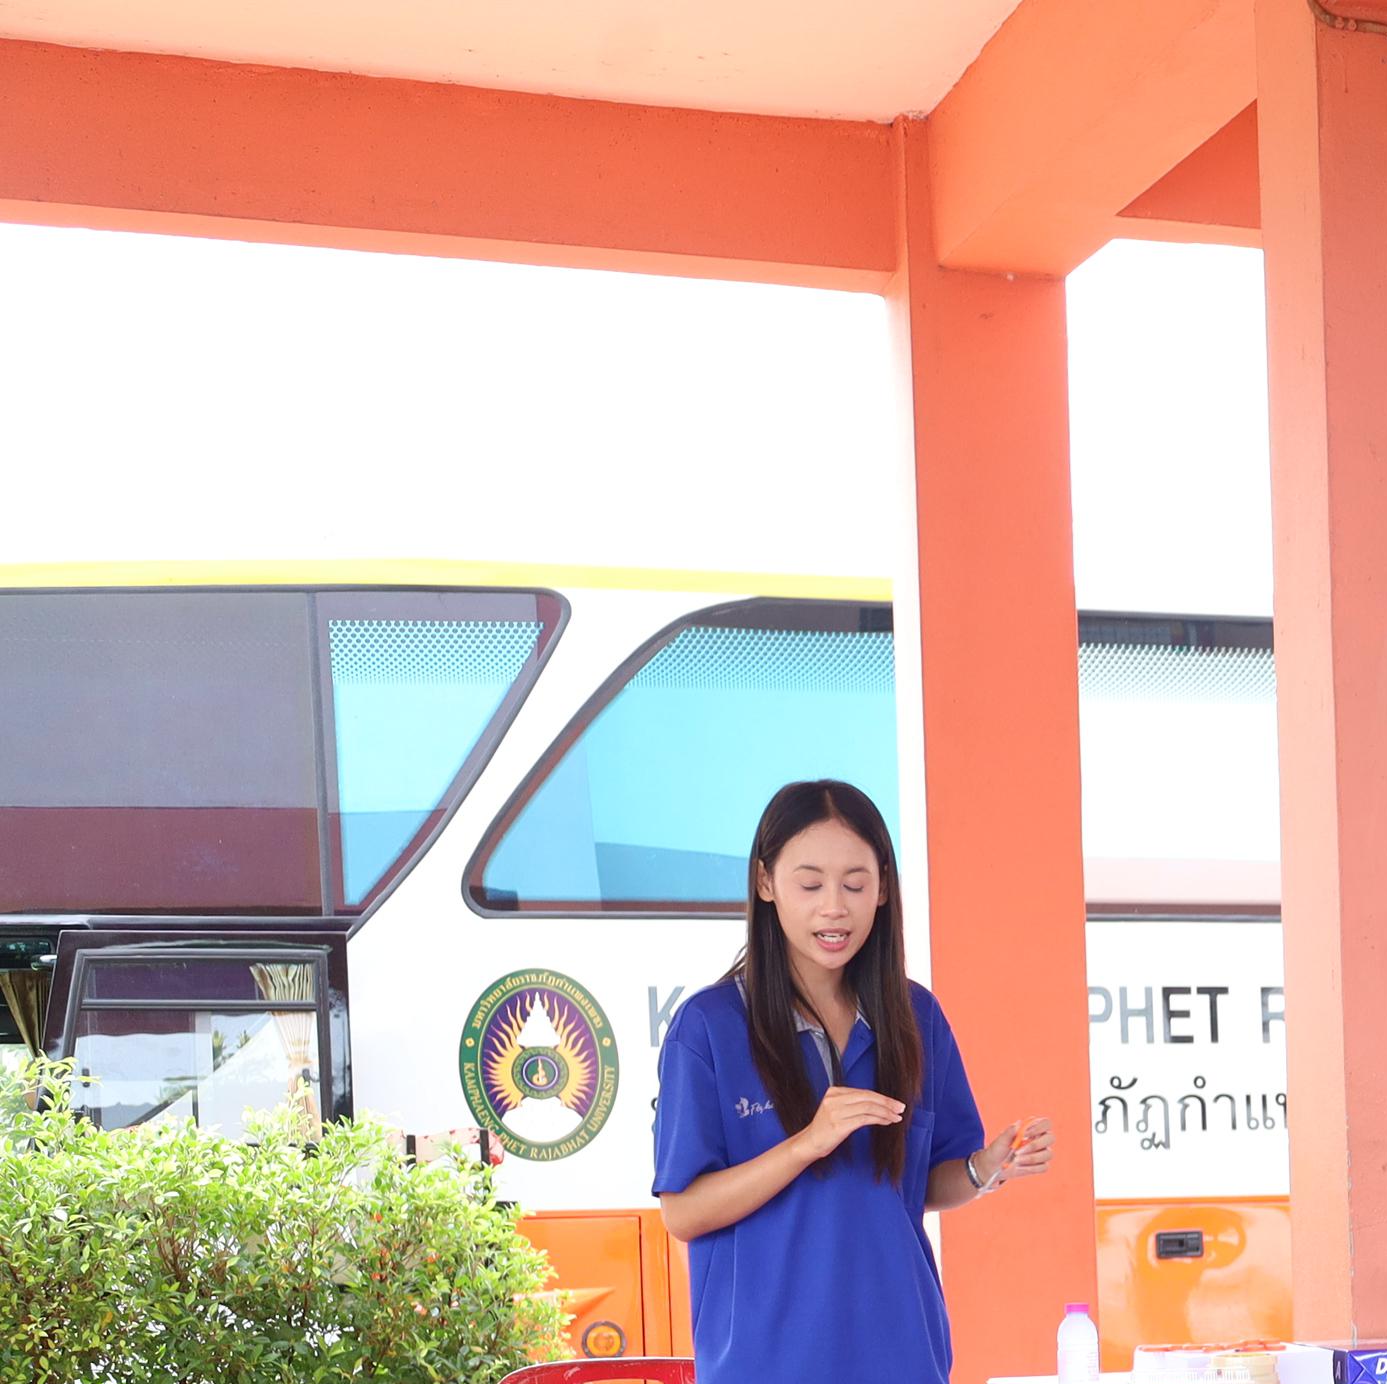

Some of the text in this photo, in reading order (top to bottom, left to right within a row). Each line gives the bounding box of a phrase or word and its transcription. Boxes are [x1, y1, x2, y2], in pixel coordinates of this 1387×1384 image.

[464, 1062, 615, 1160] KAMPHAENG PHET RAJABHAT UNIVERSITY
